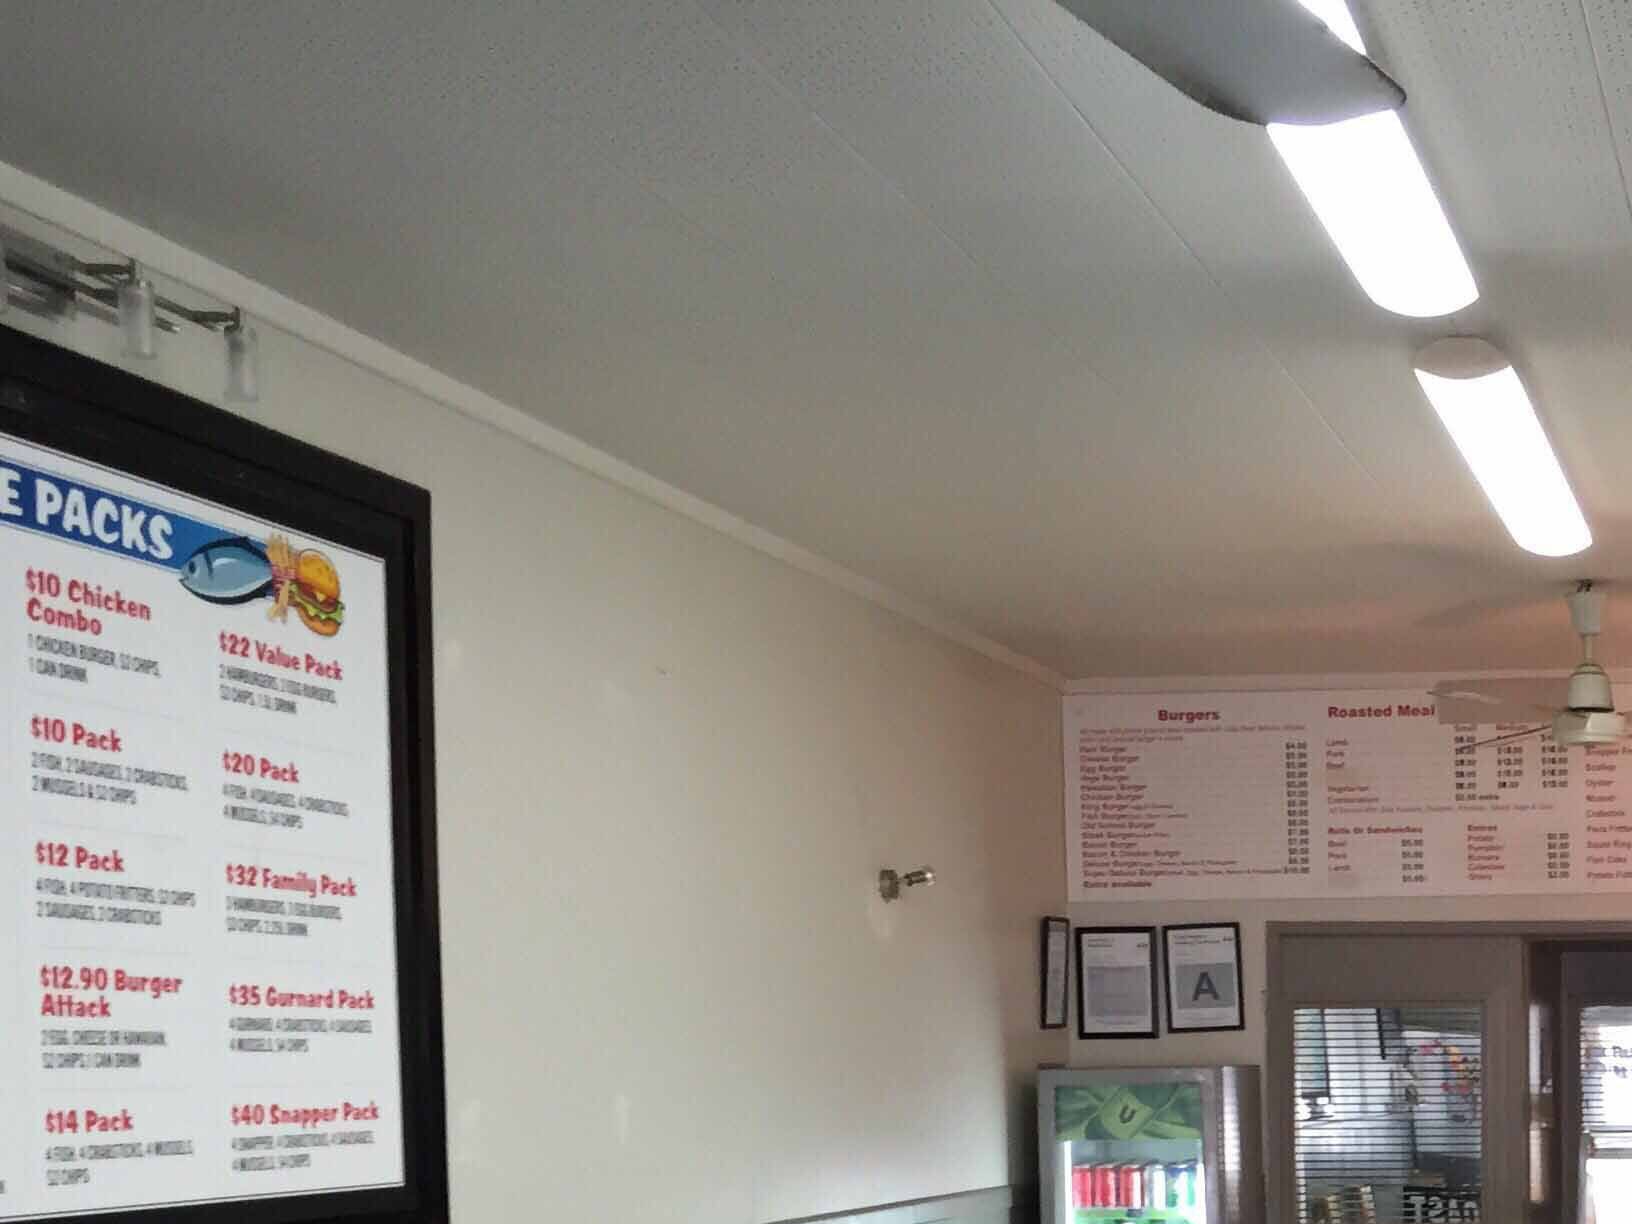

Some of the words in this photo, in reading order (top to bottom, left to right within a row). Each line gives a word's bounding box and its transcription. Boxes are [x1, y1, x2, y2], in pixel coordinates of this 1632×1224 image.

[35, 478, 173, 560] PACKS
[25, 566, 61, 598] $10
[68, 579, 152, 621] Chicken
[27, 597, 103, 636] Combo
[219, 630, 250, 658] $22
[255, 640, 300, 671] Value
[304, 653, 343, 681] Pack
[1157, 709, 1220, 722] Burgers
[1327, 705, 1392, 718] Roasted
[31, 714, 66, 743] $10
[72, 722, 122, 752] Pack
[223, 748, 256, 776] $20
[259, 757, 299, 783] Pack
[36, 841, 68, 868] $12
[75, 845, 125, 873] Pack
[226, 864, 257, 888] $32
[262, 867, 318, 898] Family
[321, 874, 357, 897] Pack
[40, 964, 108, 991] $12.90
[114, 969, 183, 998] Burger
[229, 983, 261, 1006] $35
[266, 986, 334, 1008] Gurnard
[338, 989, 375, 1009] Pack
[1191, 971, 1220, 1001] A
[41, 993, 111, 1018] Attack
[45, 1109, 78, 1133] $14
[85, 1109, 134, 1132] Pack
[231, 1103, 265, 1126] $40
[270, 1103, 338, 1129] Snapper
[342, 1101, 379, 1120] Pack
